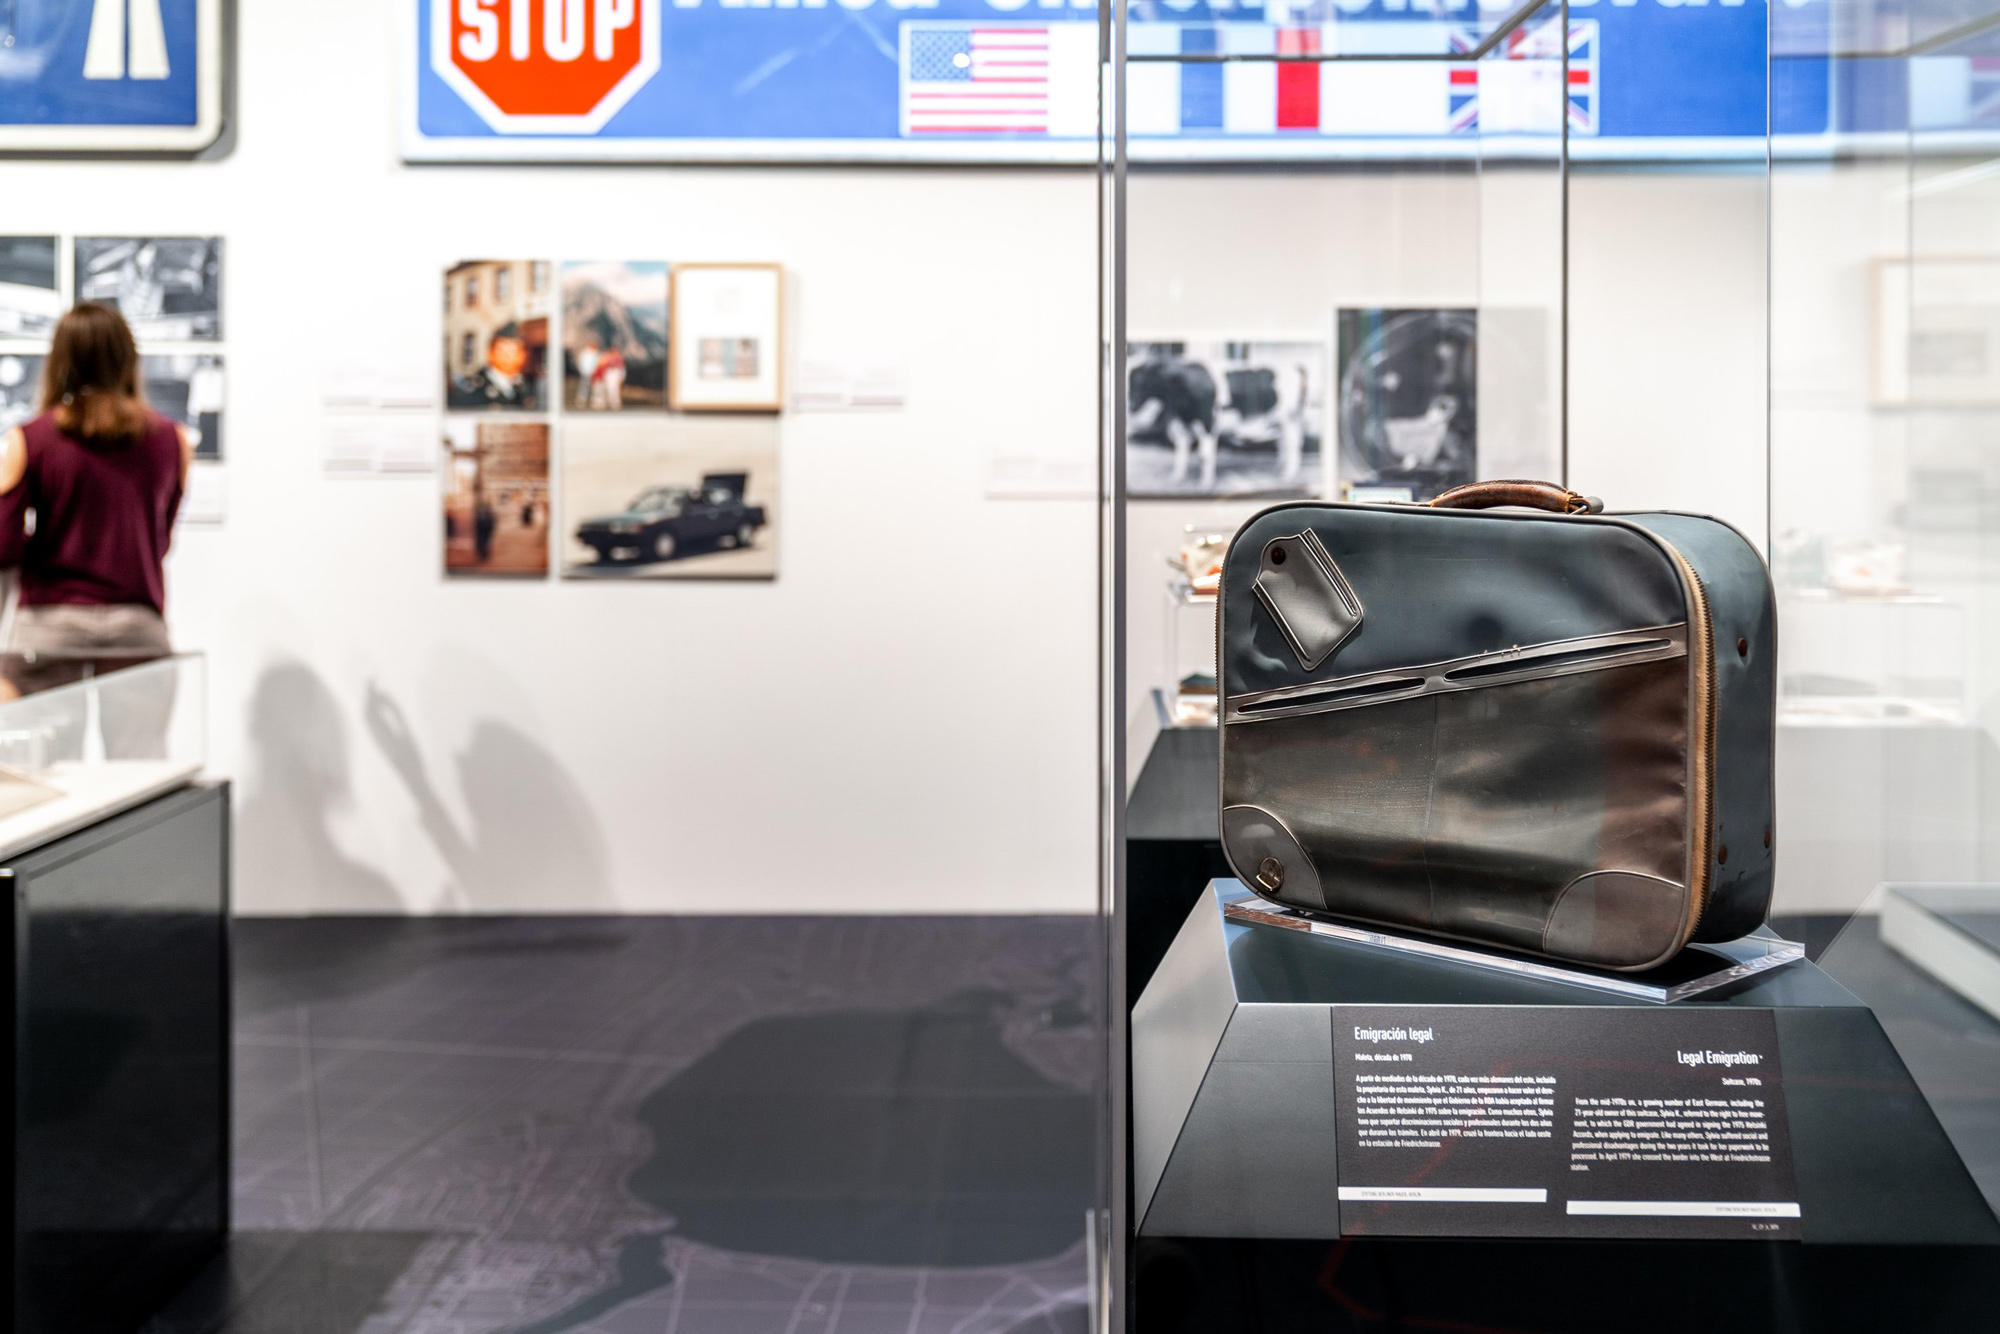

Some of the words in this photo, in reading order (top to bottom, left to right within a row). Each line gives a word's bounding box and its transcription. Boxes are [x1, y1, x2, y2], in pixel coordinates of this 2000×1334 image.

[458, 0, 634, 62] STOP
[1355, 1027, 1407, 1043] Emigración
[1409, 1028, 1434, 1043] legal
[1677, 1051, 1705, 1067] Legal
[1706, 1051, 1758, 1067] Emigration
